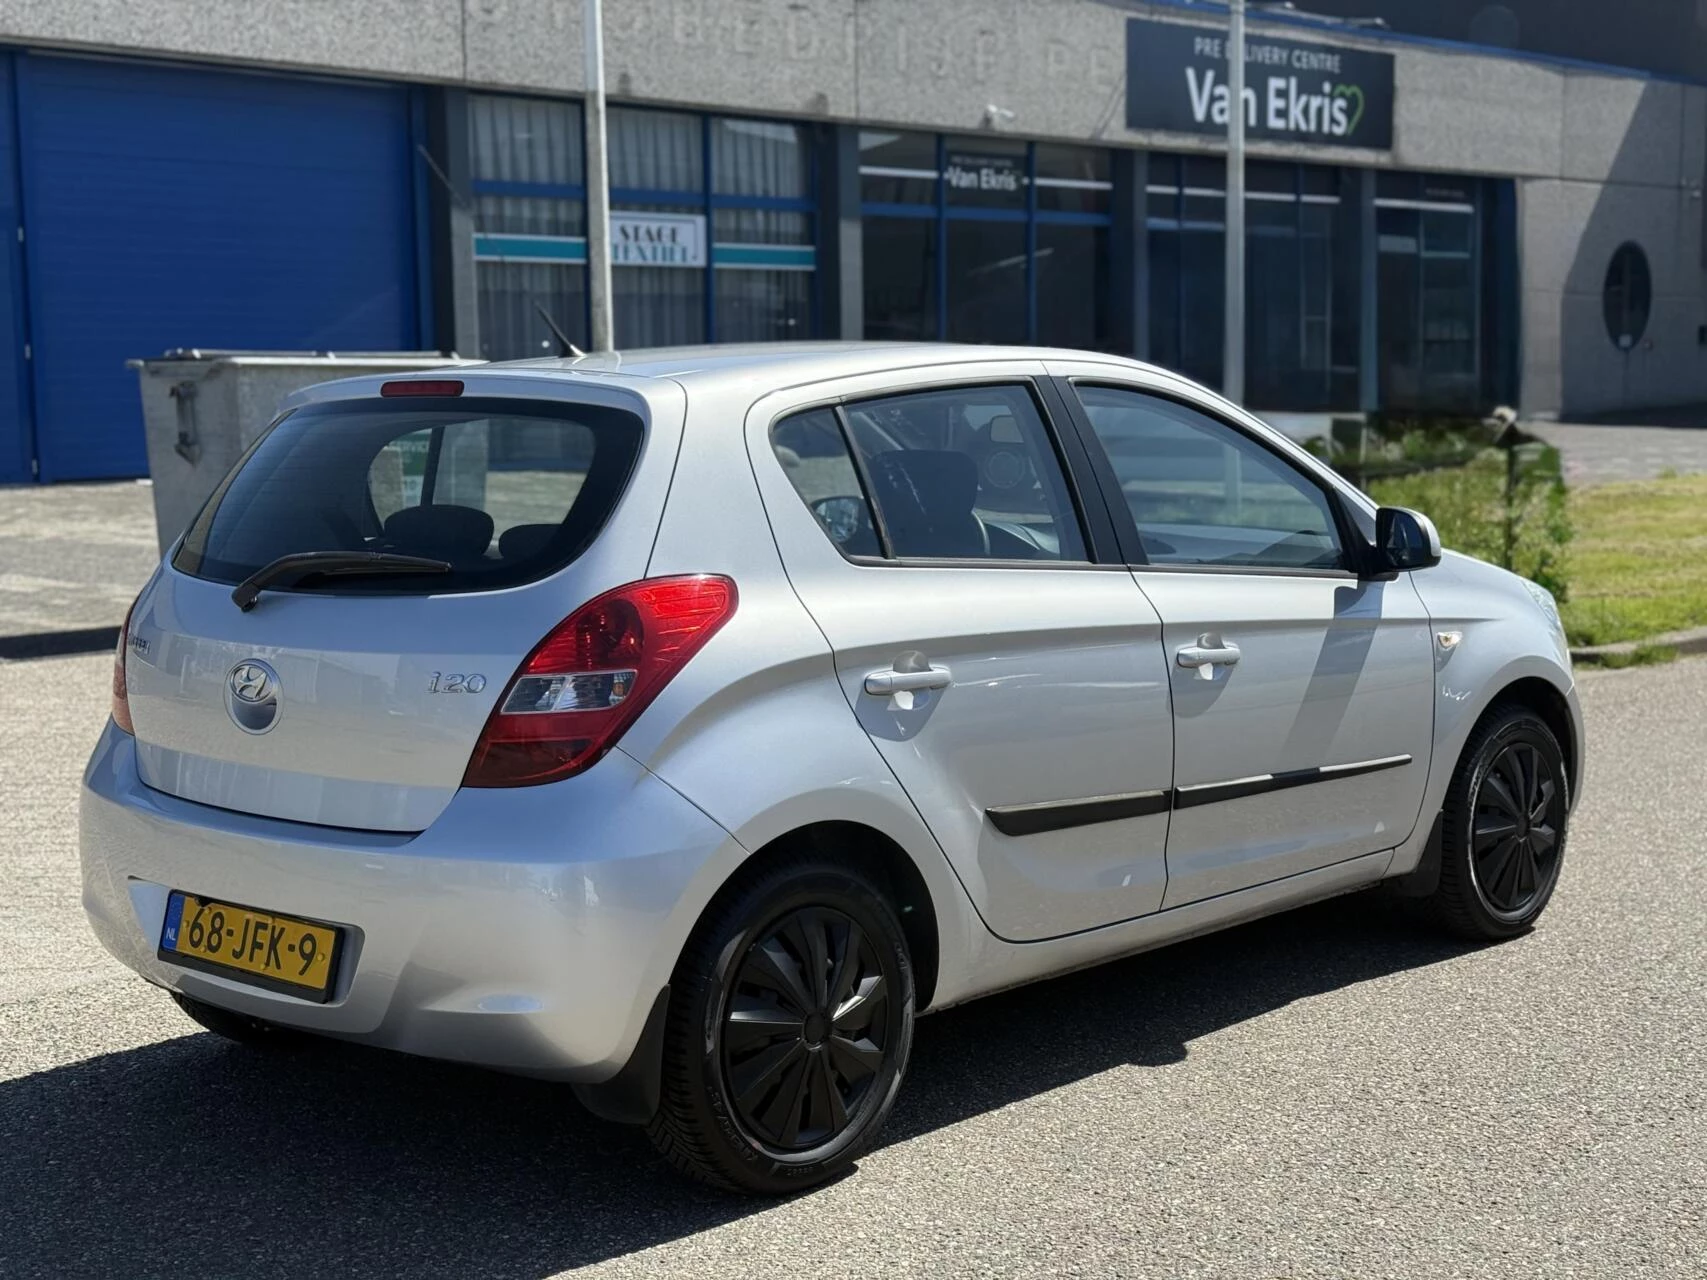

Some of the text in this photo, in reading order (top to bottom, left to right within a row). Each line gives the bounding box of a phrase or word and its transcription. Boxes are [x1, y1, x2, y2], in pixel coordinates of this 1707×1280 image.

[1194, 36, 1342, 73] PRE LIVERY CENTRE
[1185, 66, 1348, 136] Van Ekris
[165, 926, 177, 942] NL
[188, 907, 318, 976] 68-JFK-9
